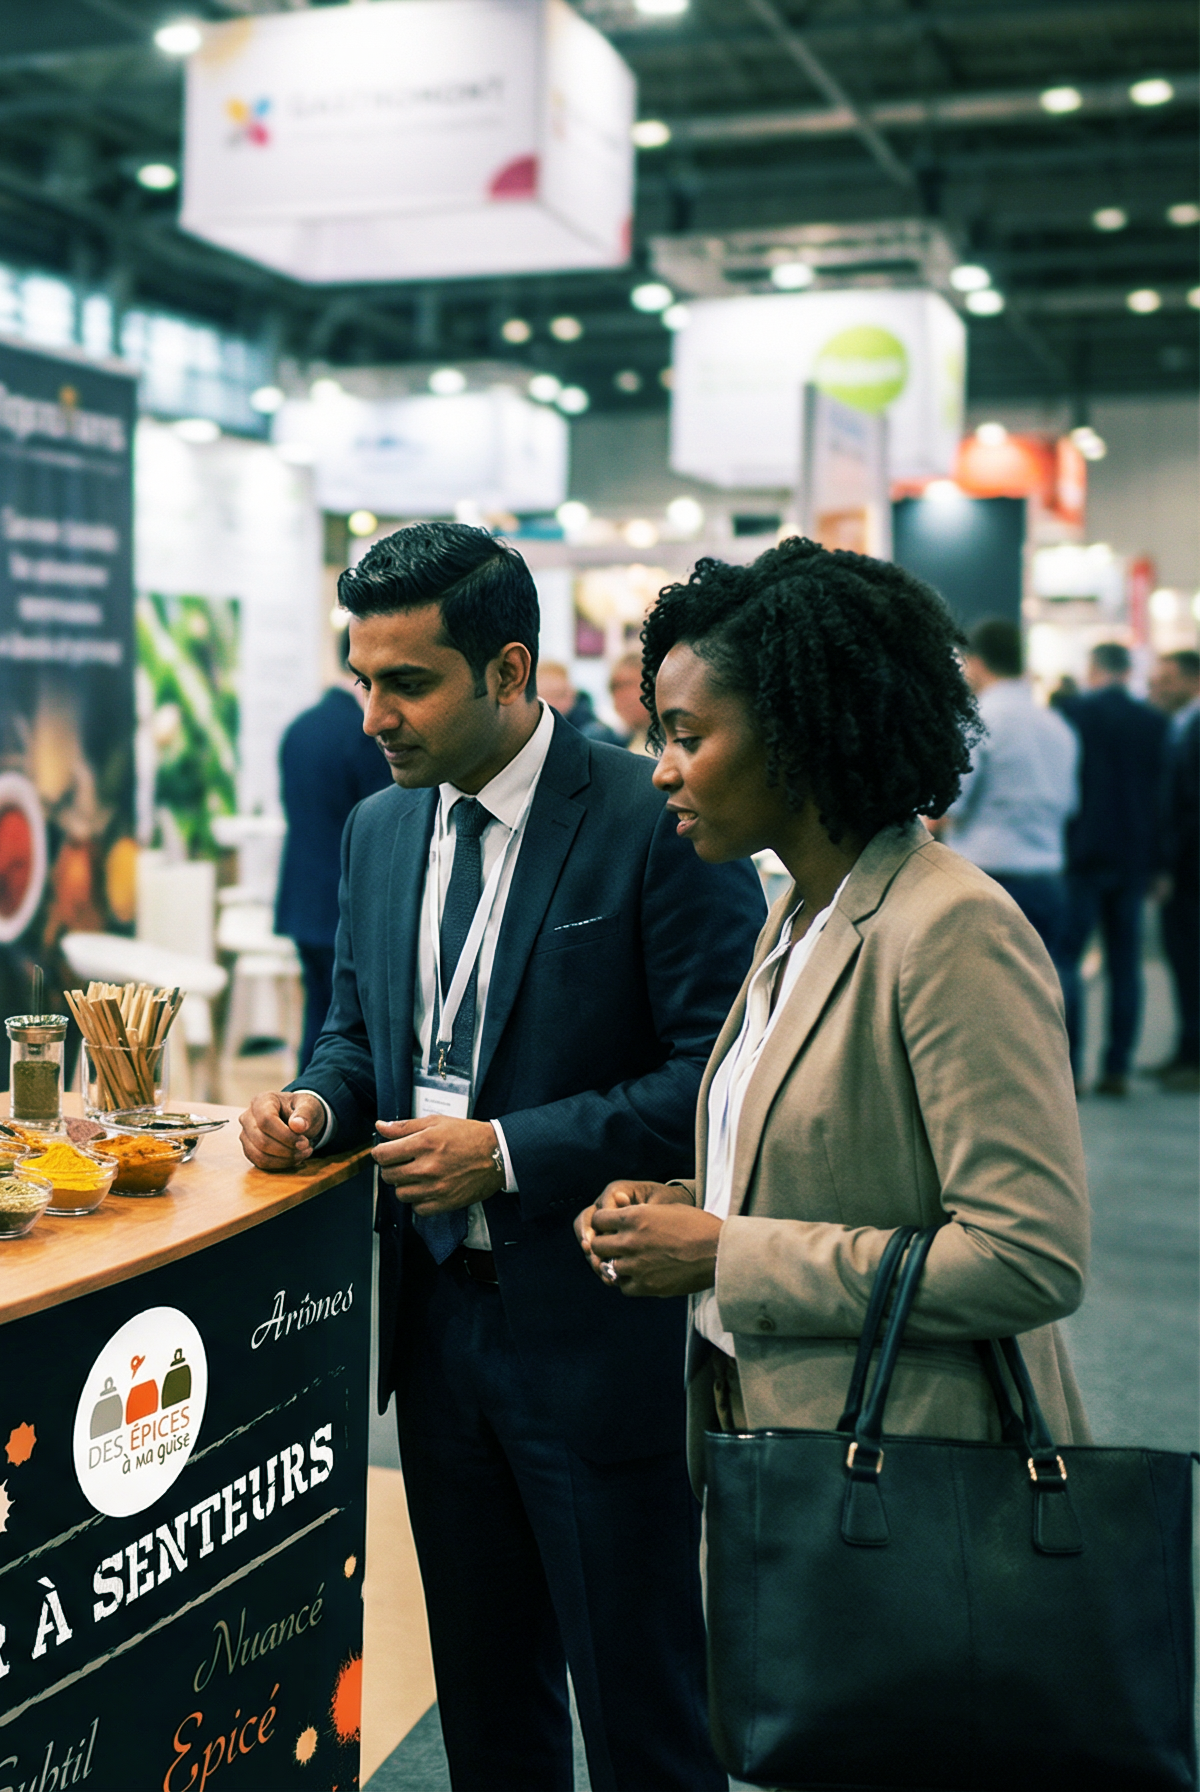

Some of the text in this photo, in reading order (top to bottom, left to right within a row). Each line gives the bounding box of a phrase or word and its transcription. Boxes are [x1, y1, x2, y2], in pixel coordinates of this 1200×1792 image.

[88, 1405, 190, 1470] DES ÉPICES
[122, 1453, 131, 1475] à
[32, 1576, 74, 1660] À
[92, 1422, 335, 1623] SENTEURS
[193, 1582, 326, 1692] Nuancé
[163, 1682, 280, 1792] Epicé
